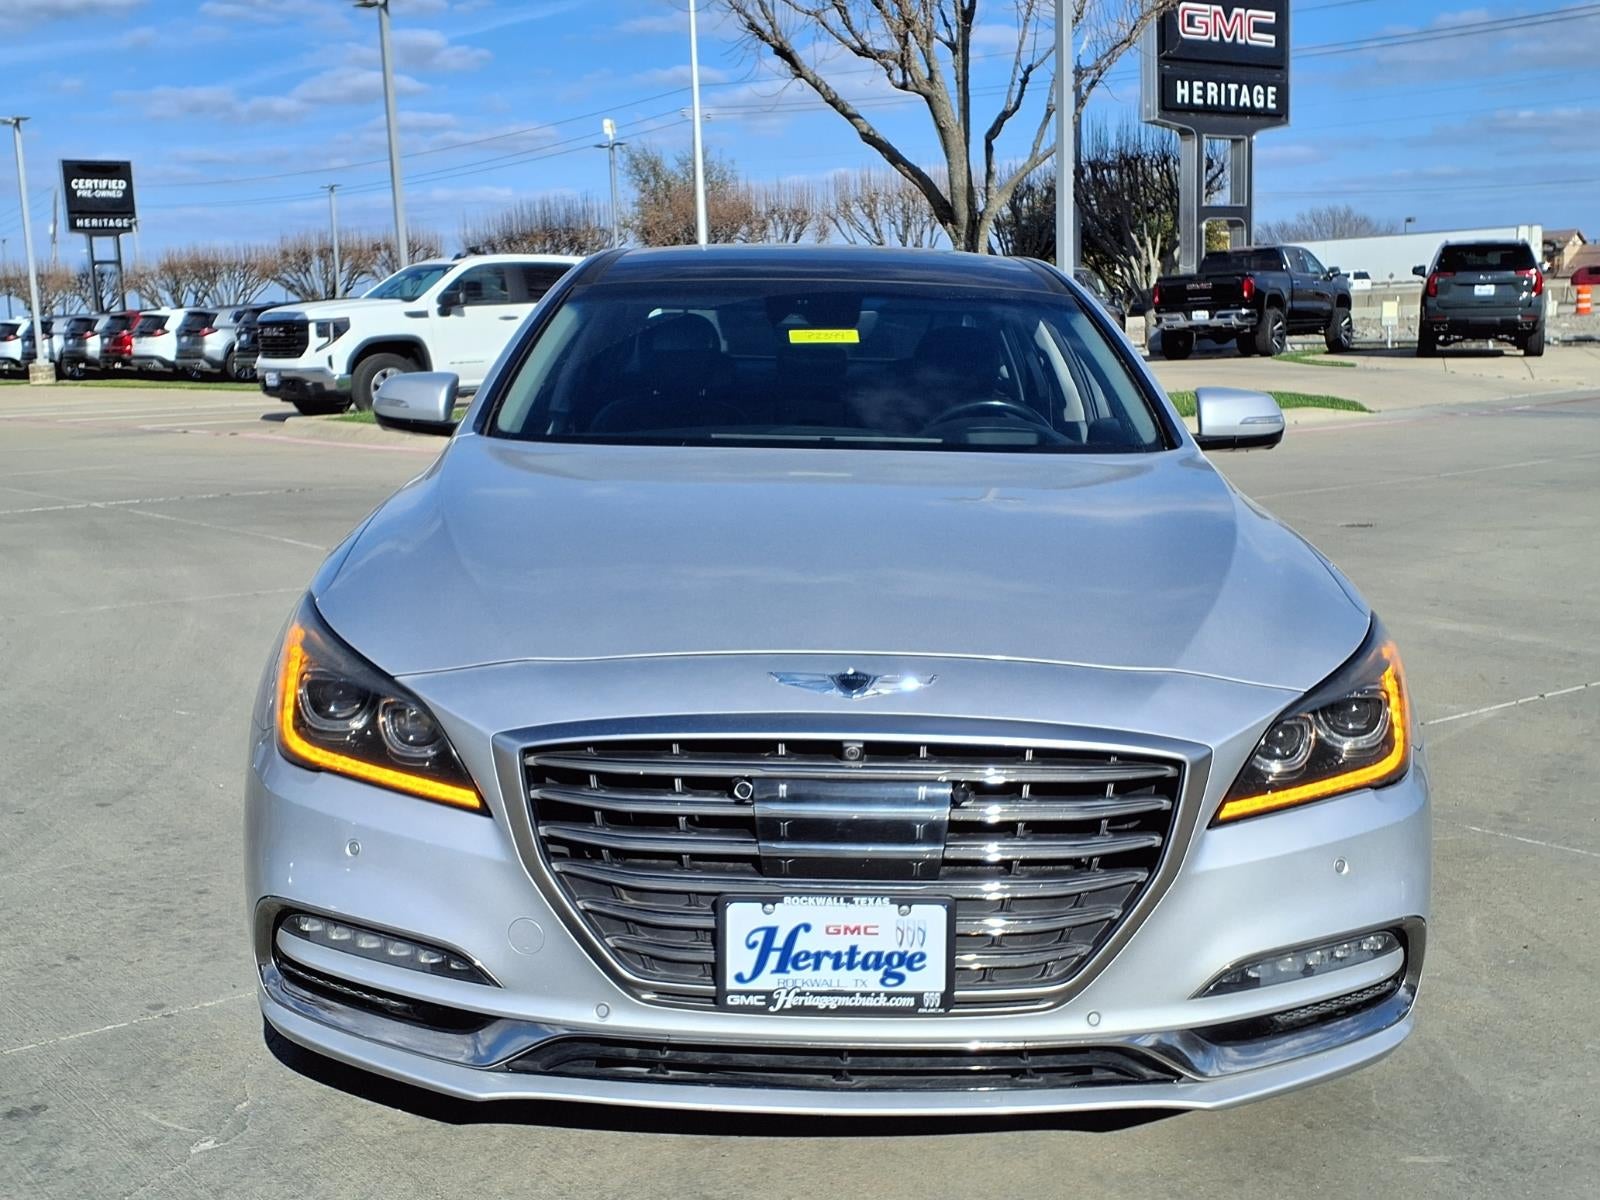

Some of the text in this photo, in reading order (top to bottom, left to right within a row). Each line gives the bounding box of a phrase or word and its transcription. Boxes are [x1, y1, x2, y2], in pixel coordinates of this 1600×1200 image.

[1178, 1, 1276, 48] GMC
[1176, 79, 1277, 109] HERITAGE
[71, 178, 127, 190] CERTIFIED
[76, 189, 123, 198] PRE-OWNED
[76, 218, 129, 228] HERITAGE
[853, 897, 890, 906] TEXAS
[825, 924, 879, 936] GMC
[734, 922, 927, 988] Heritage
[853, 978, 868, 988] TX
[727, 987, 915, 1012] GMC Heritagegmcbuick.com
